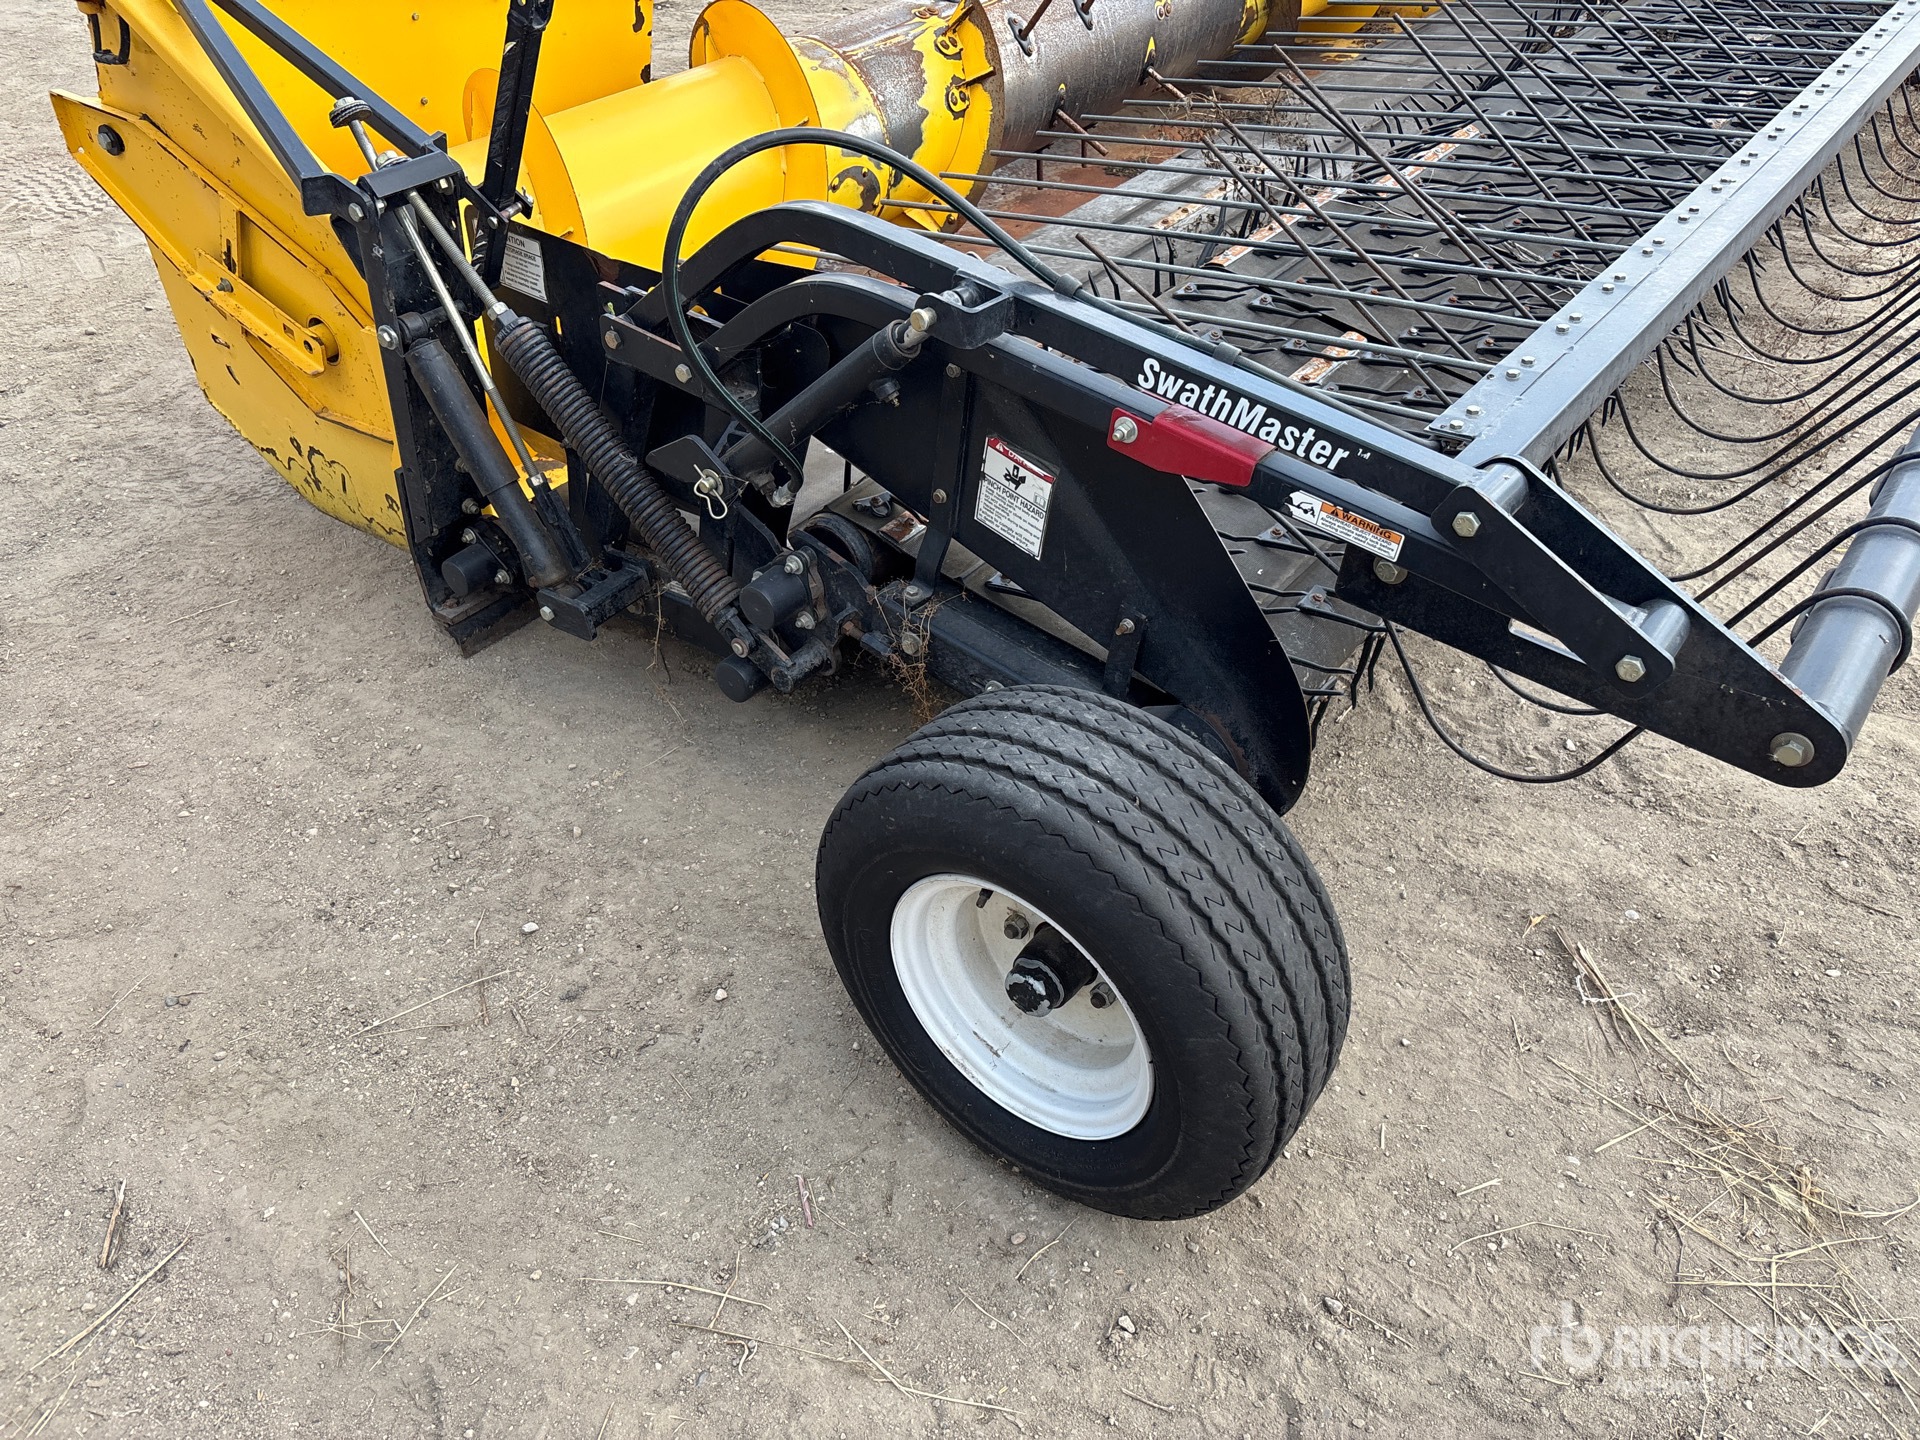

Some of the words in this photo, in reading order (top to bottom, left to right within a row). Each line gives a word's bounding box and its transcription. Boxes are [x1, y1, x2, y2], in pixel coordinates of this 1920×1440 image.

[1137, 357, 1350, 470] SwathMaster
[984, 476, 1001, 493] PINCH
[1002, 487, 1020, 504] POINT
[1020, 499, 1044, 520] HAZARD
[1321, 517, 1336, 527] Always
[1337, 524, 1354, 534] activate
[1355, 532, 1369, 541] safety
[1380, 543, 1394, 552] before
[1322, 522, 1338, 532] working
[1326, 515, 1351, 528] OVERHEAD
[1352, 526, 1370, 537] OBJECT
[1372, 535, 1392, 546] HAZARD
[1342, 513, 1392, 539] WARNING
